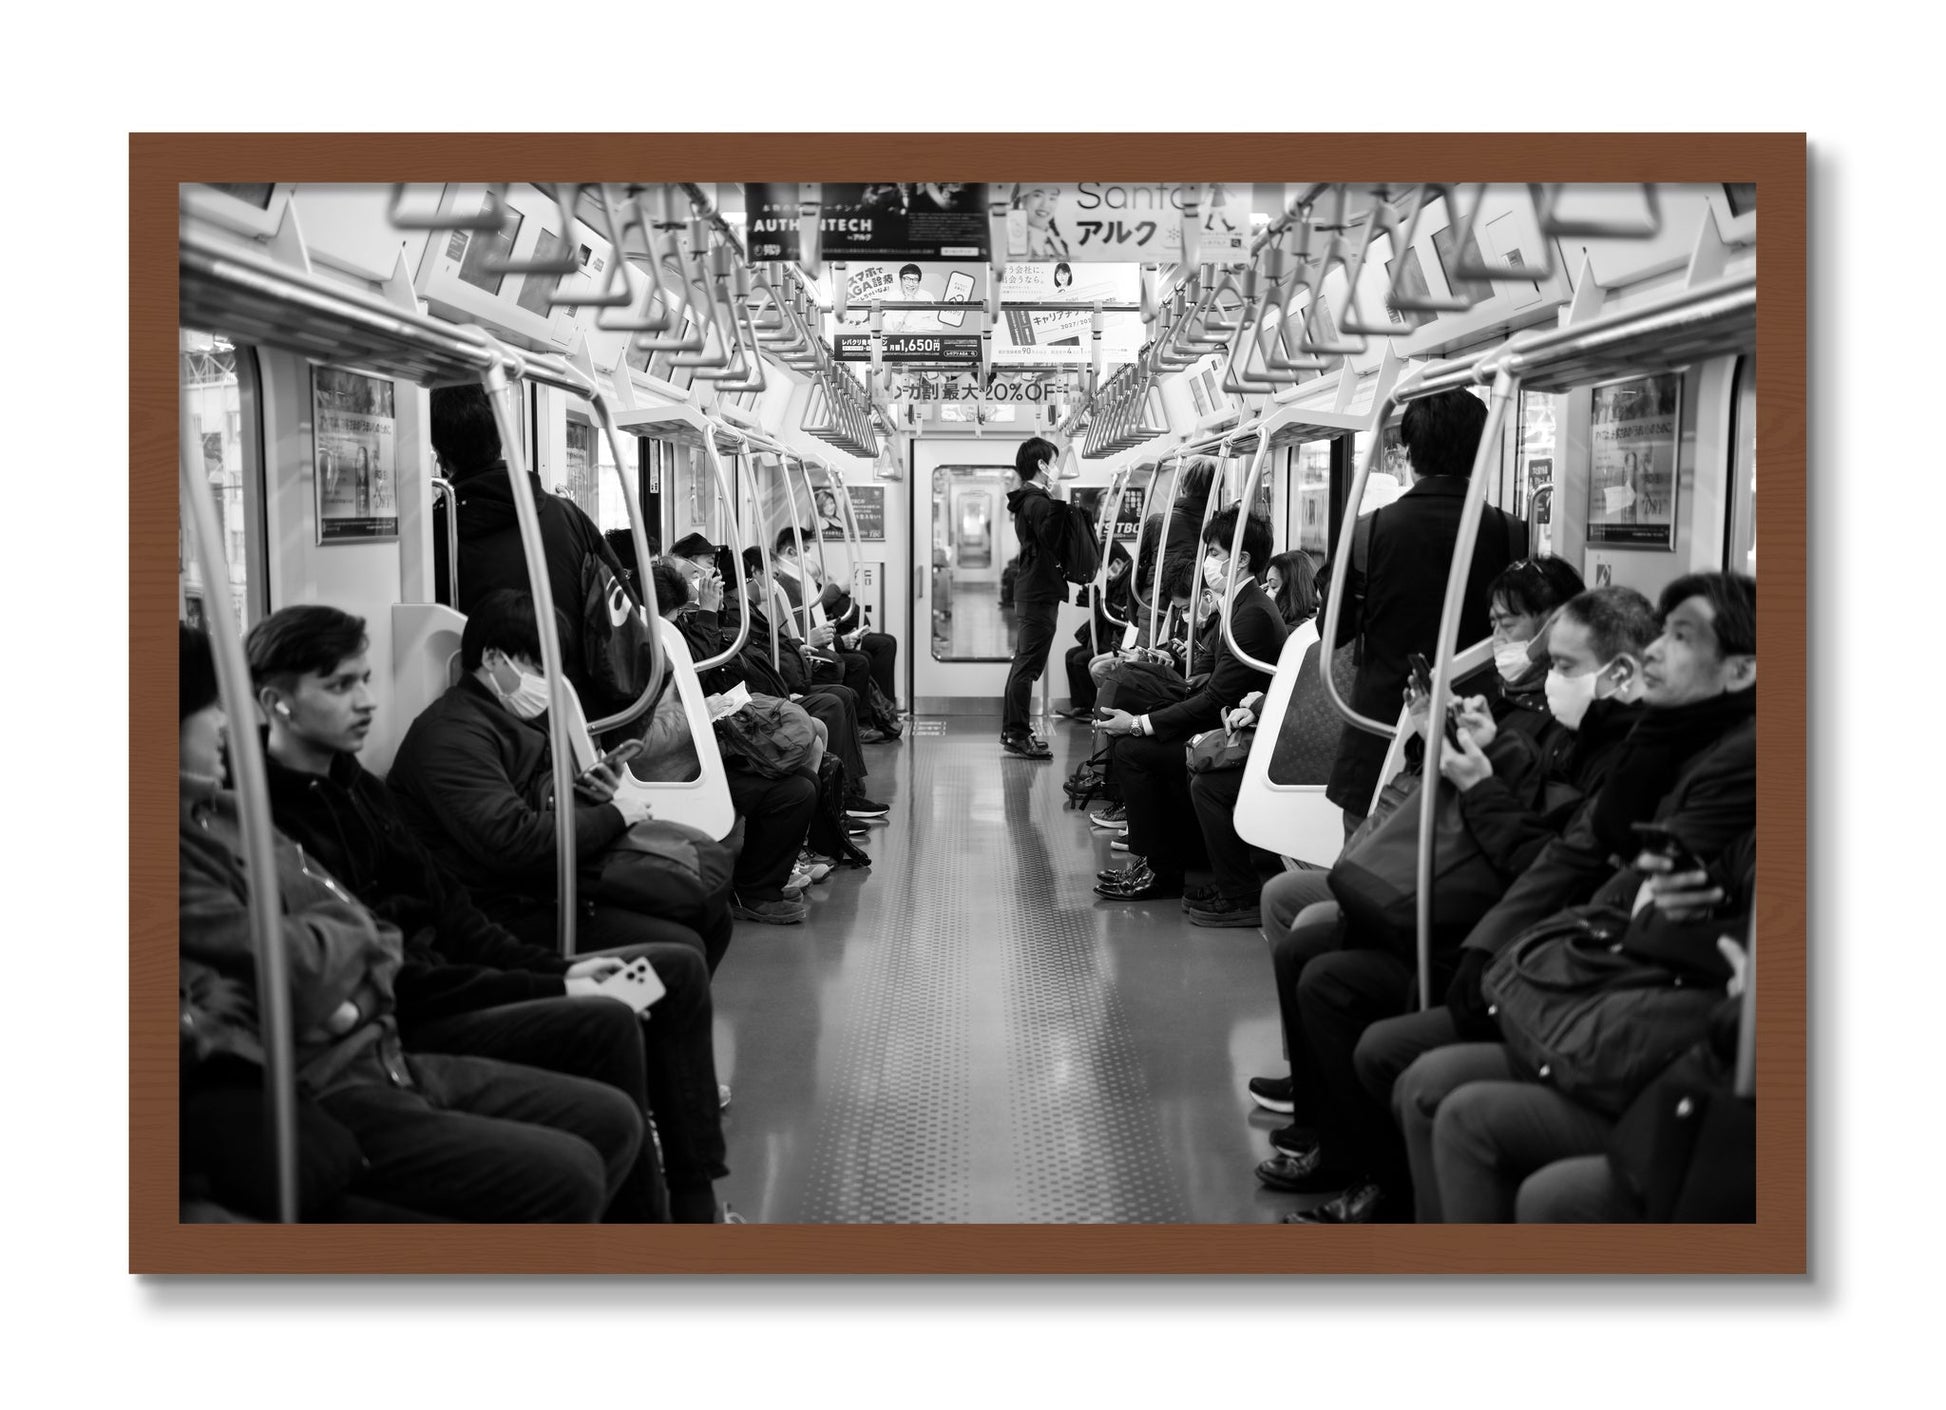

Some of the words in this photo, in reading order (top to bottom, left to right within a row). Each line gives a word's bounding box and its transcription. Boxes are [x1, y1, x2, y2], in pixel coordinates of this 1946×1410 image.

[1076, 220, 1157, 247] アルク
[1003, 266, 1044, 274] う会社に、
